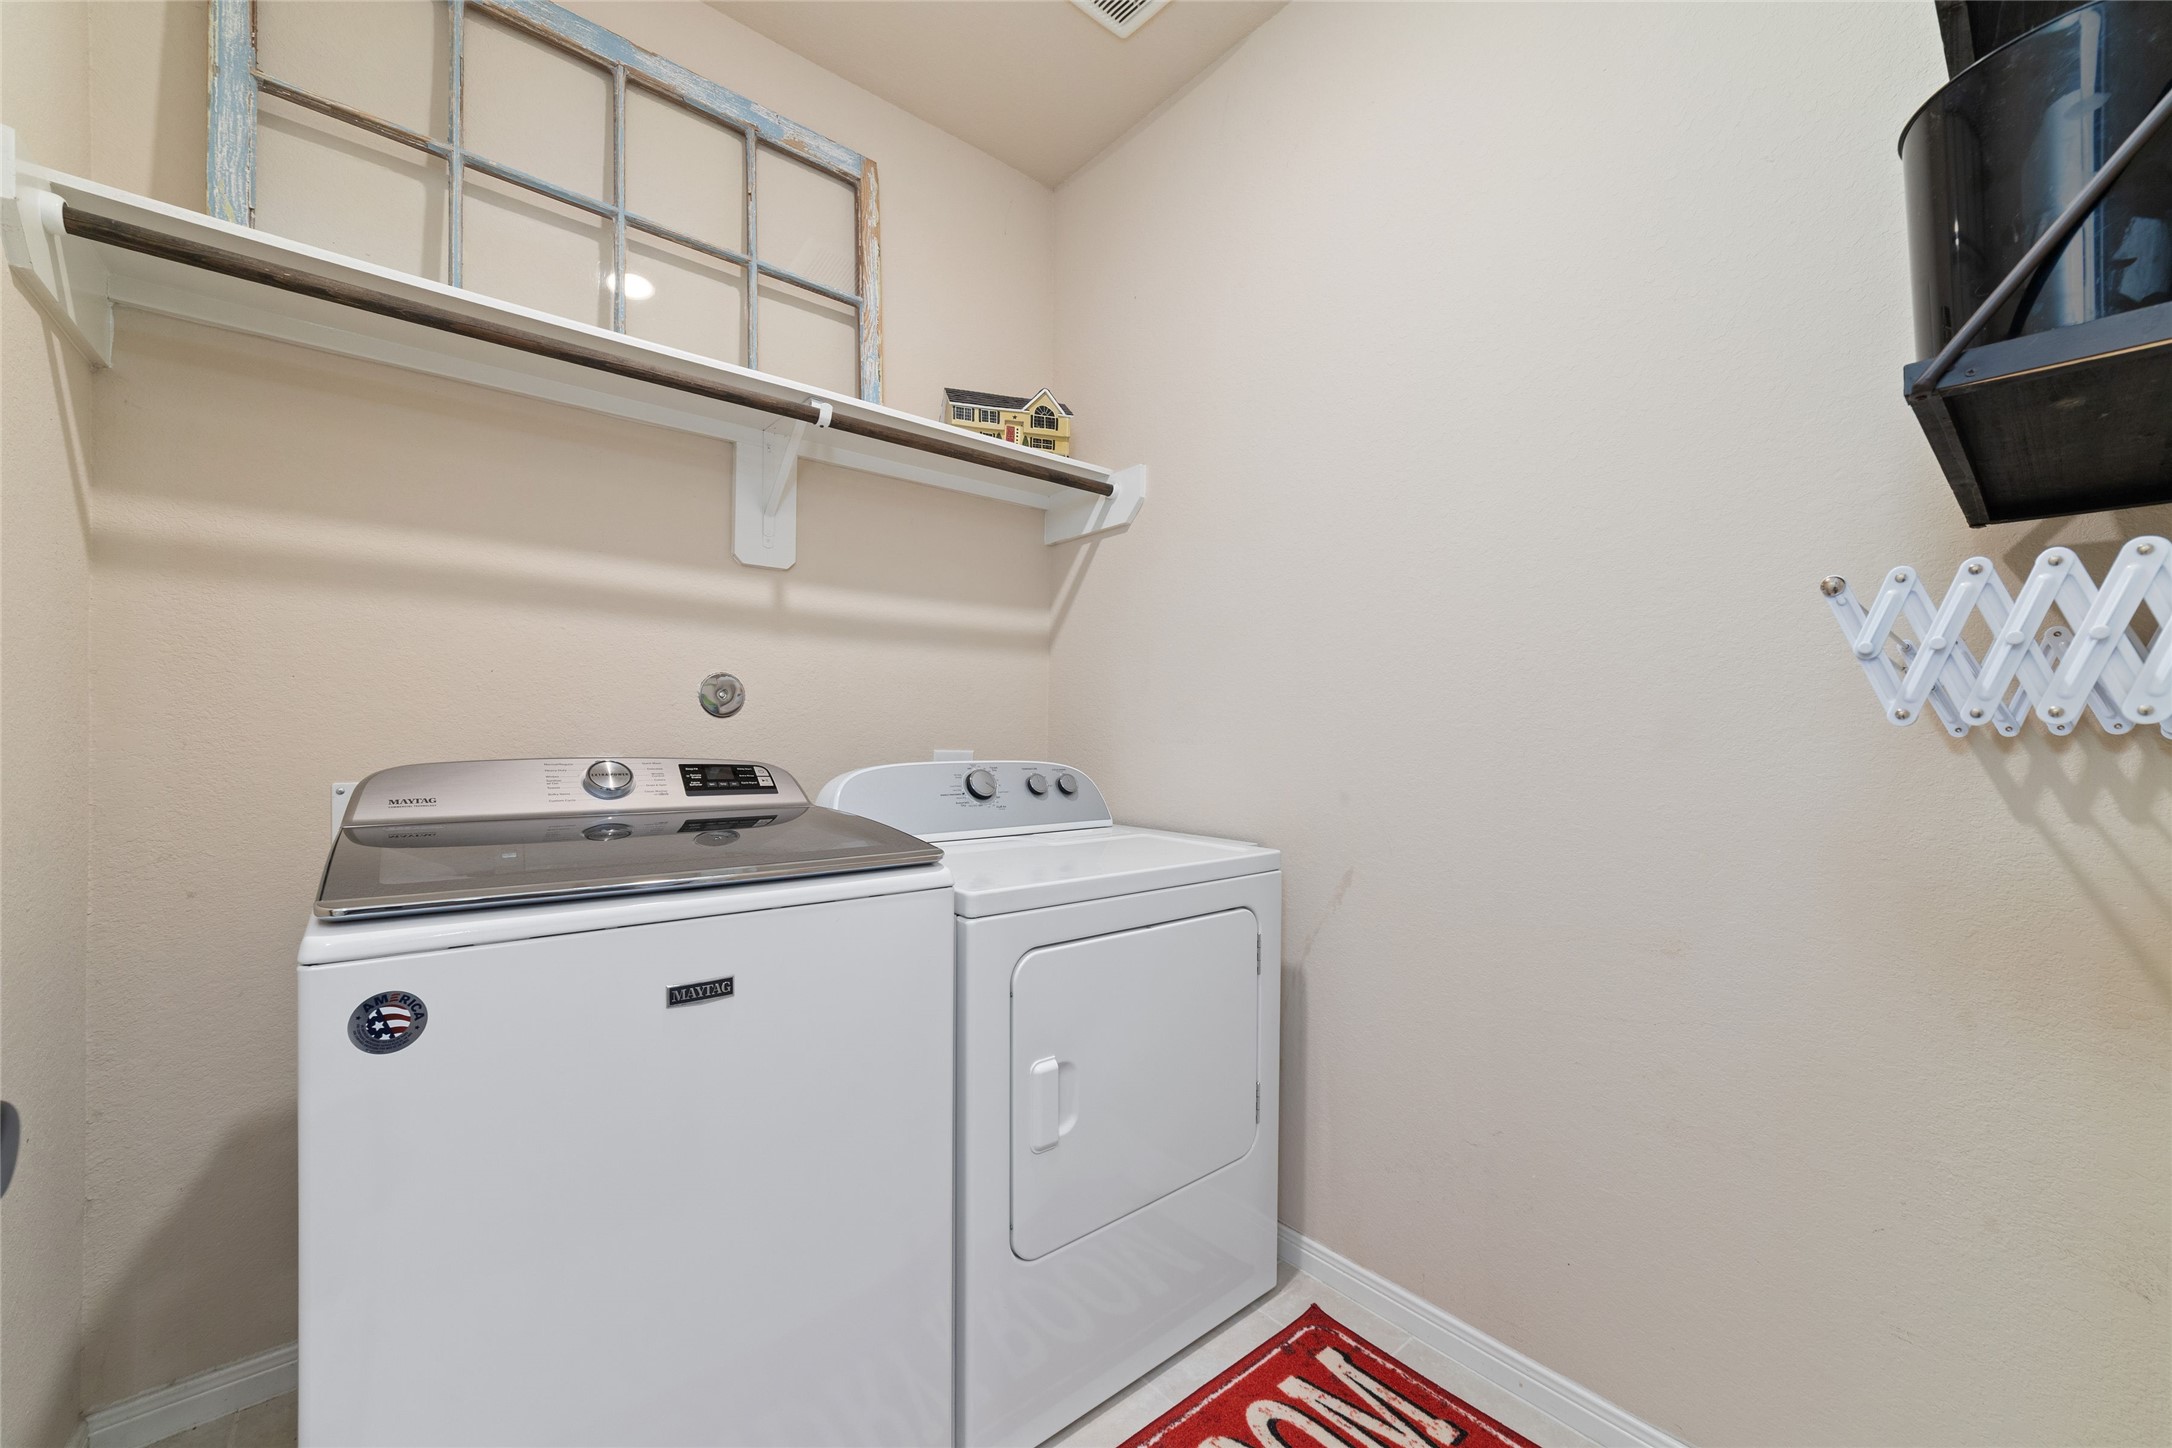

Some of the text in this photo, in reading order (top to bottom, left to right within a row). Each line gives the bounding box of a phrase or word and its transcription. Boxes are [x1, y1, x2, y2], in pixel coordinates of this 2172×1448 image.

[388, 797, 437, 805] MAYTAG
[671, 981, 731, 1002] MAYTAG
[362, 993, 425, 1022] AMERICA
